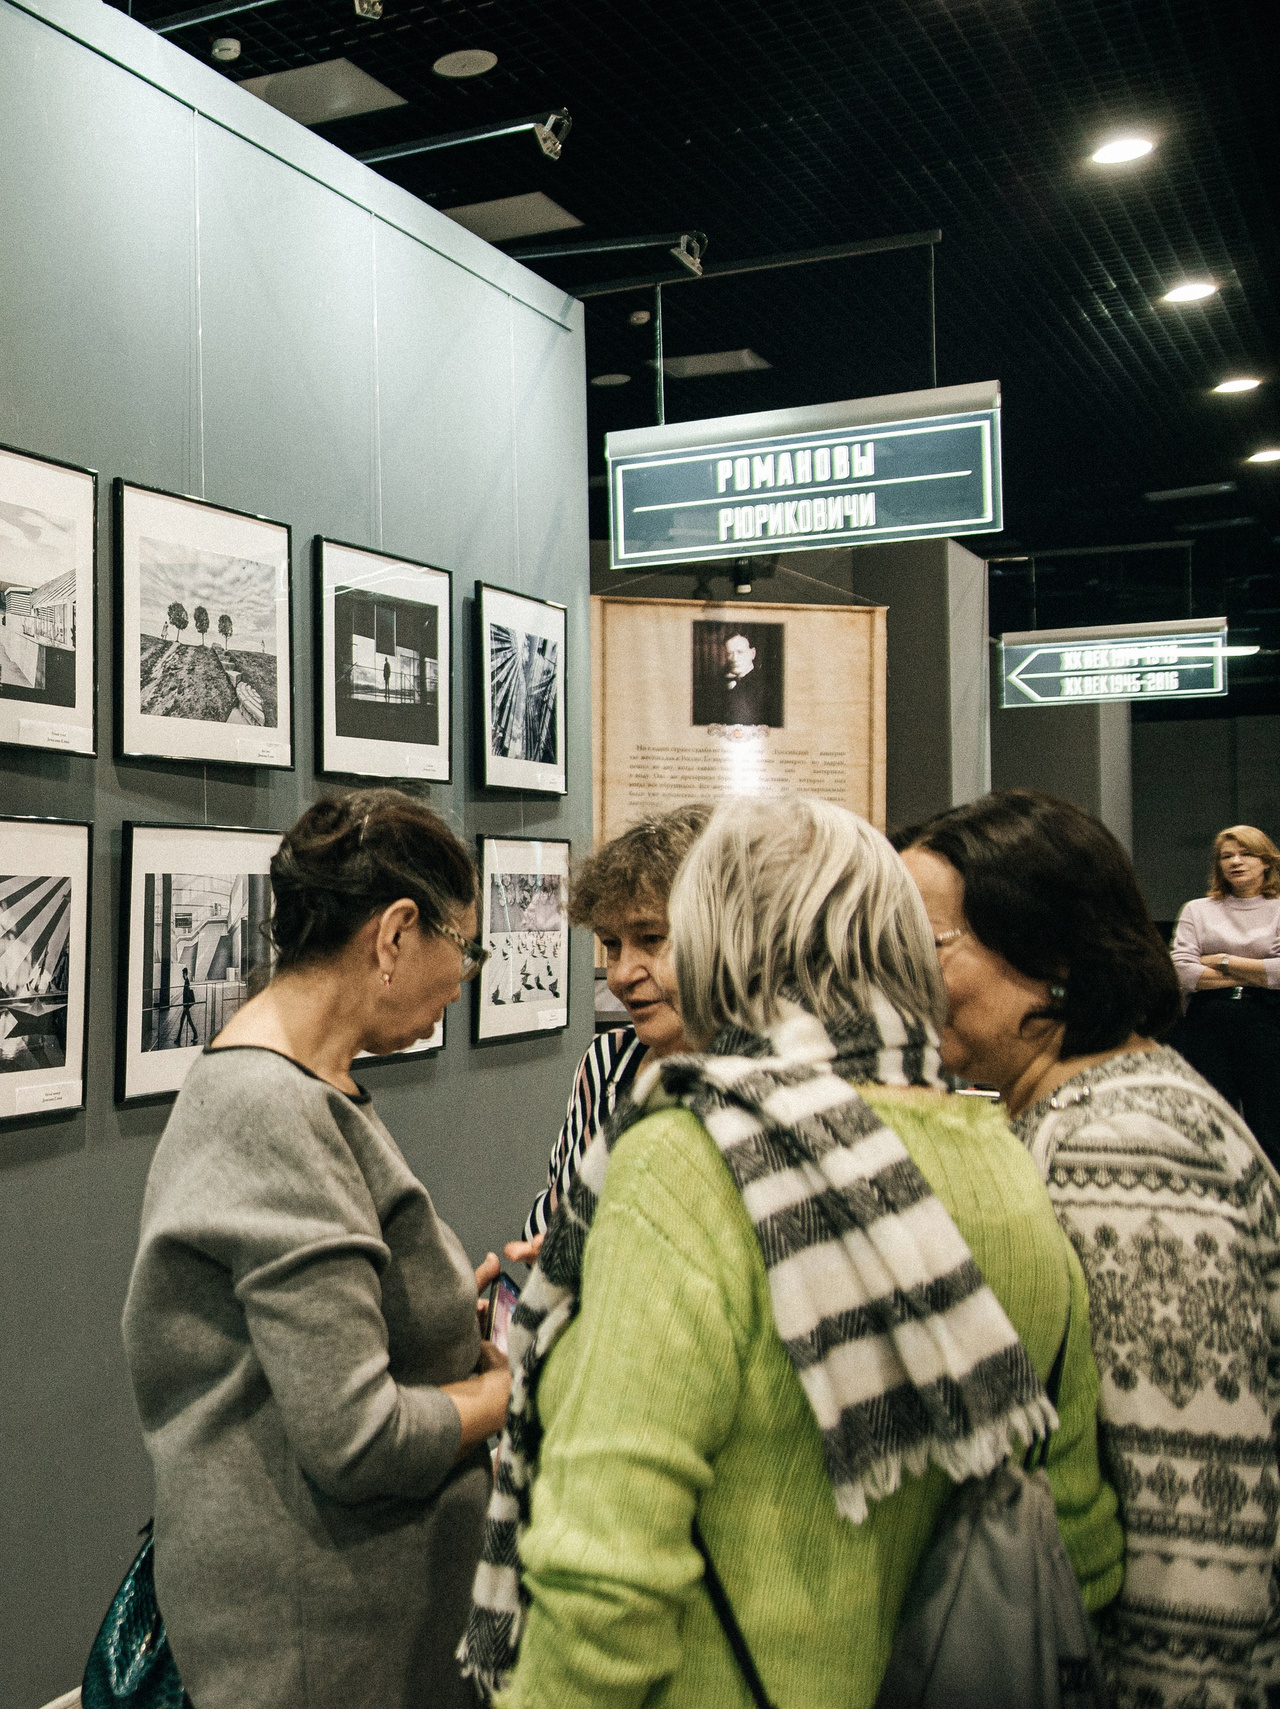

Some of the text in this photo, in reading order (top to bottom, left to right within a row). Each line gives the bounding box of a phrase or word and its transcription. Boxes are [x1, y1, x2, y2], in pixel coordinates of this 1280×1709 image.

[717, 441, 875, 493] РОМАНОВЫ
[718, 492, 876, 541] РЮРИКОВИЧИ
[1082, 675, 1108, 694] ВЕК
[1108, 671, 1179, 693] 1945-2016
